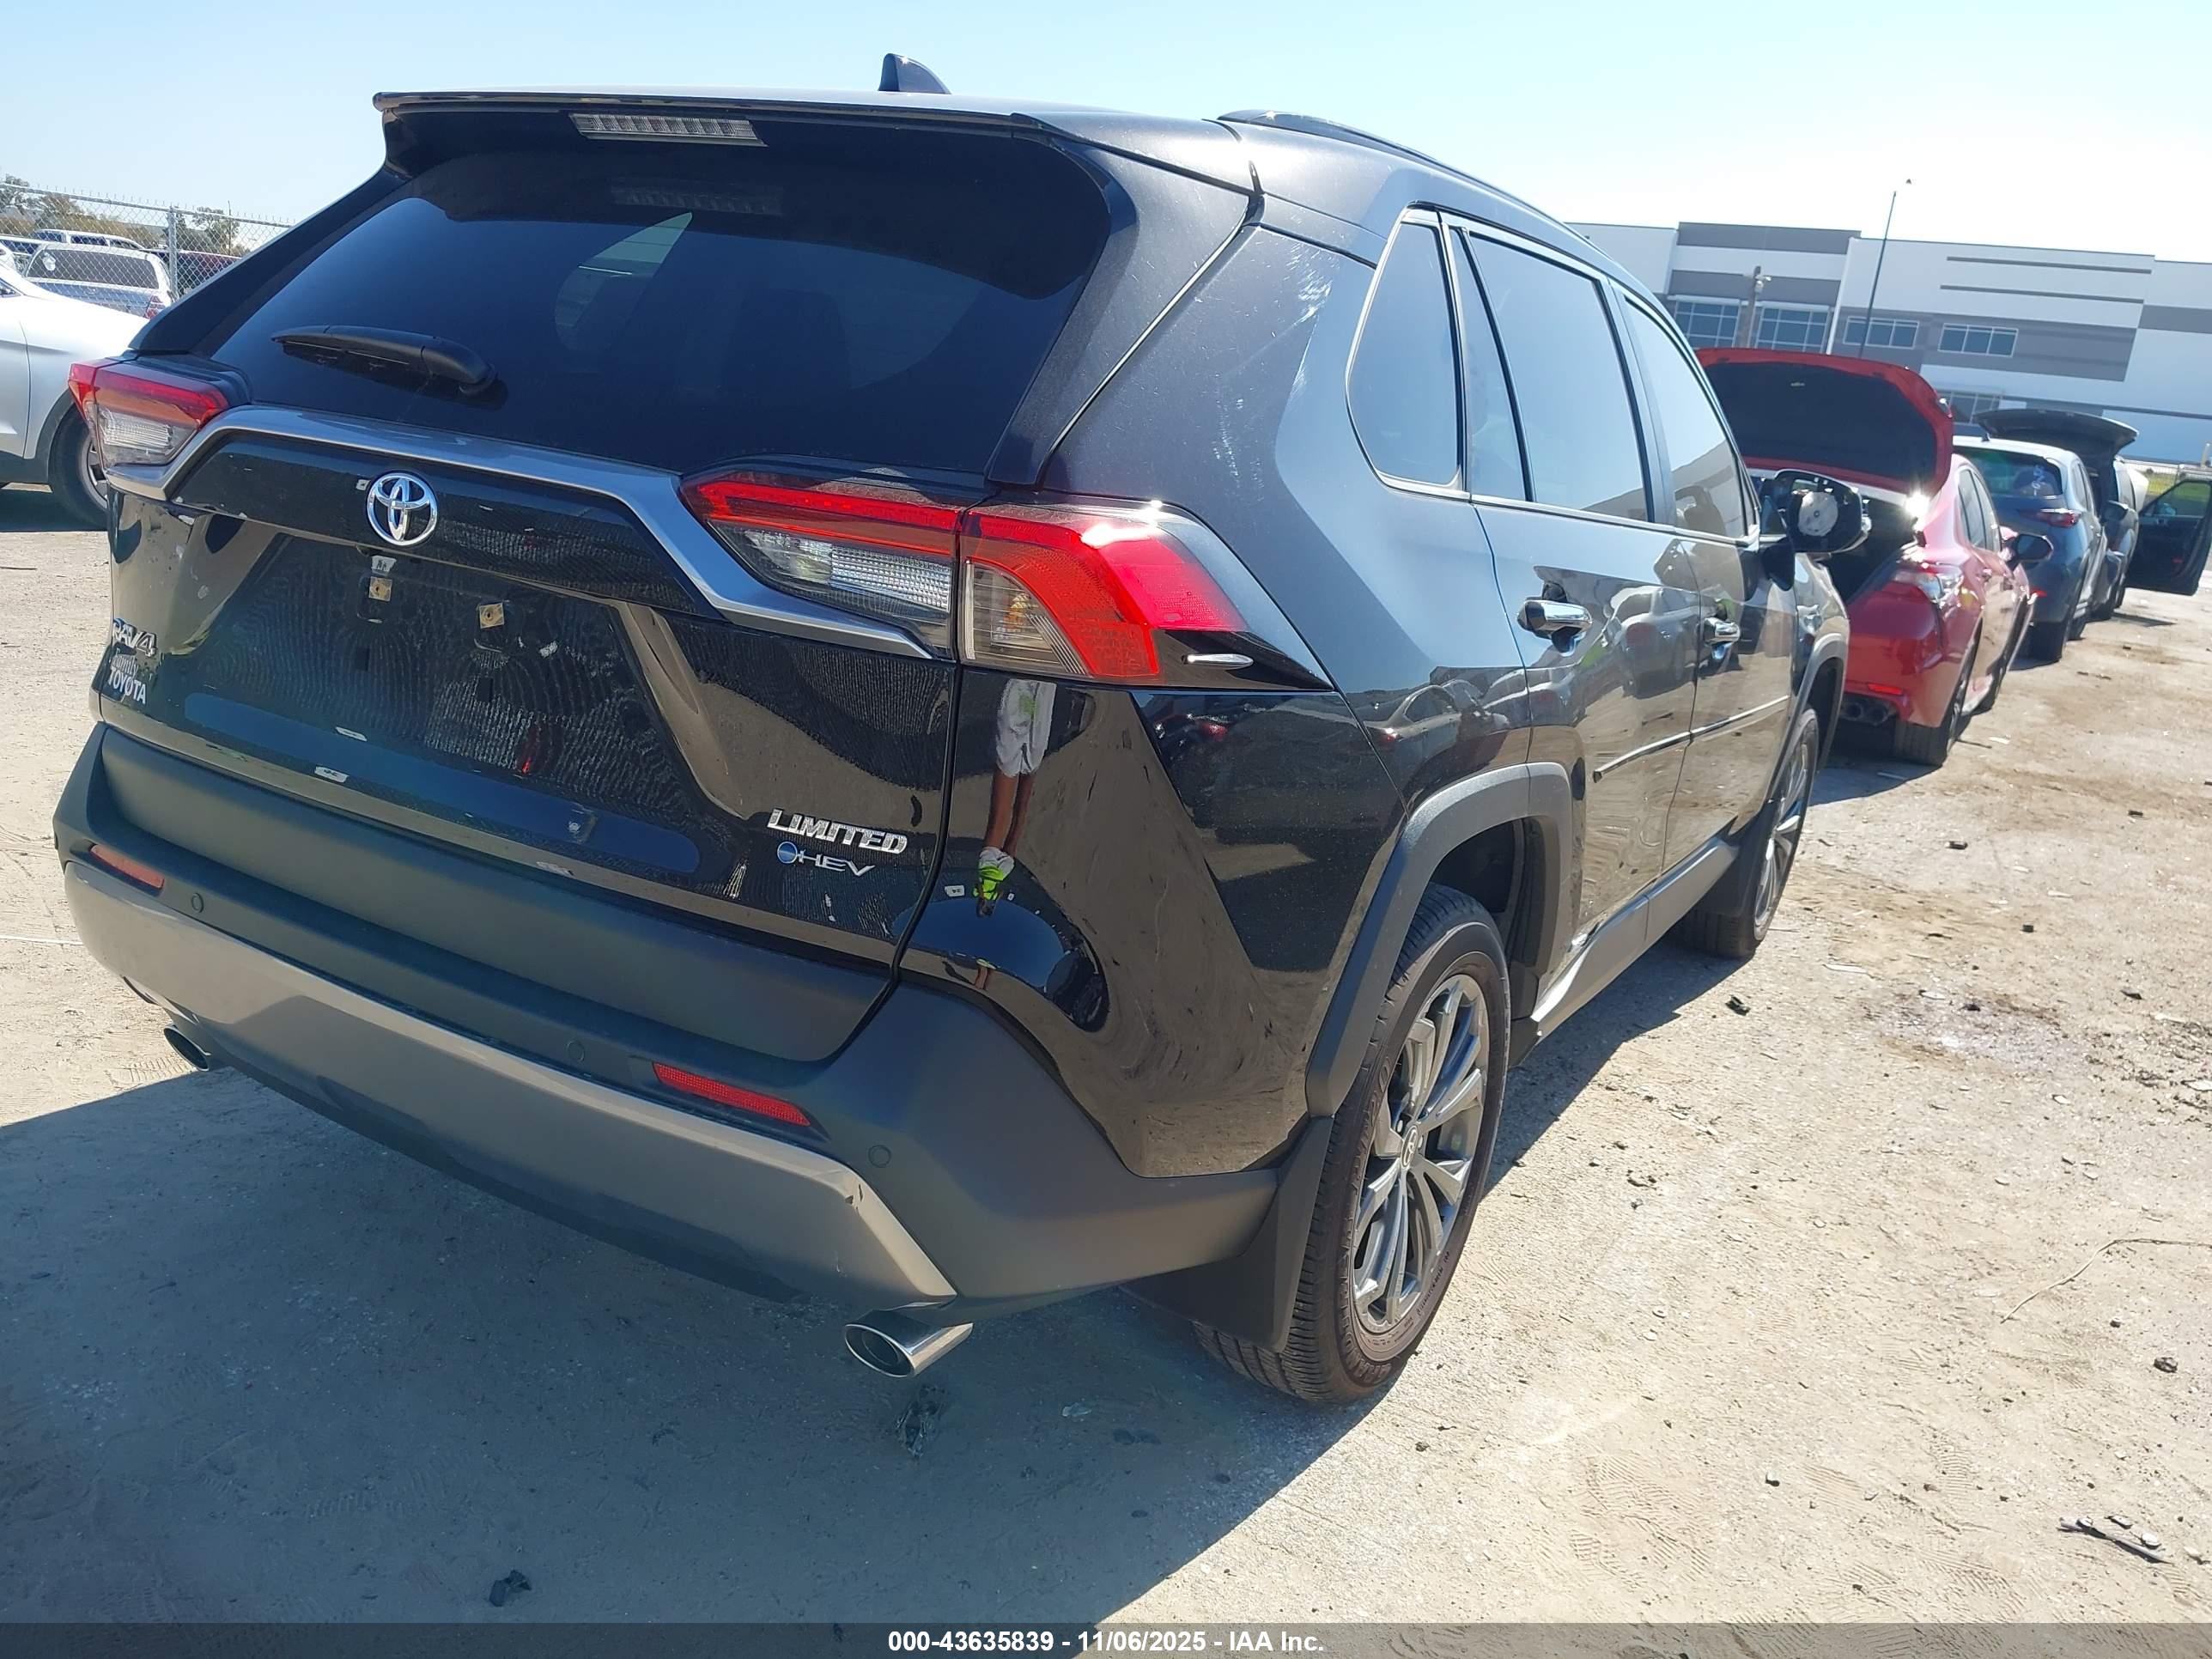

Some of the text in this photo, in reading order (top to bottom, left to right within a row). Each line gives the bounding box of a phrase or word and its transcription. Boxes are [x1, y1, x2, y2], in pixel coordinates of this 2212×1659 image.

[112, 618, 157, 658] RAV4
[108, 665, 147, 704] TOYOTA
[767, 808, 908, 854] LIMITED
